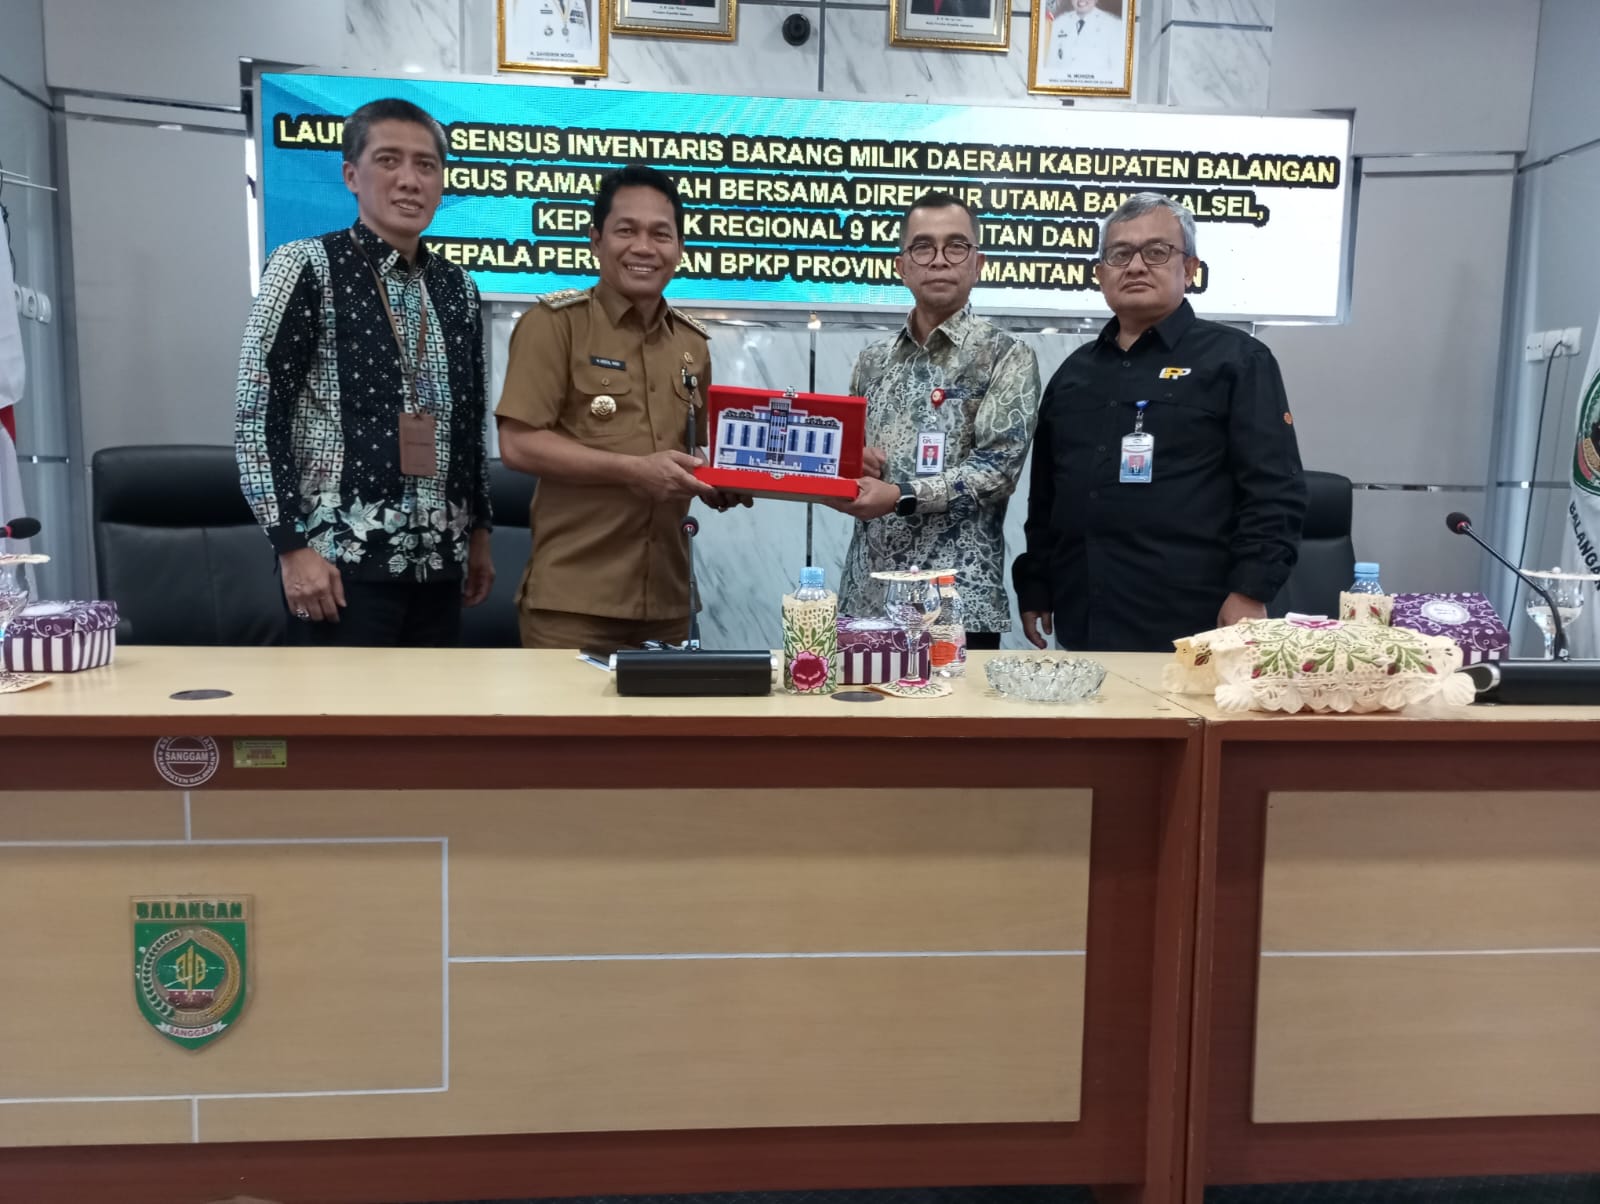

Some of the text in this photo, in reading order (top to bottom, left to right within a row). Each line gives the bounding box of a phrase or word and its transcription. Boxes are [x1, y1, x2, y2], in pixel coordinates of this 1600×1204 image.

[451, 128, 1335, 183] SENSUS INVENTARIS BARANG MILIK DAERAH KABUPATEN BALANGAN
[719, 178, 848, 204] BERSAMA
[991, 188, 1077, 213] UTAMA
[1169, 194, 1264, 221] ALSEL,
[710, 214, 843, 240] REGIONAL
[850, 219, 864, 241] 9
[1042, 225, 1093, 248] DAN
[720, 252, 789, 276] BPKP
[796, 255, 901, 280] PROVIN
[165, 751, 209, 761] SANGGAM
[136, 902, 242, 919] BALANGAN
[169, 1027, 215, 1037] SANGGAM
